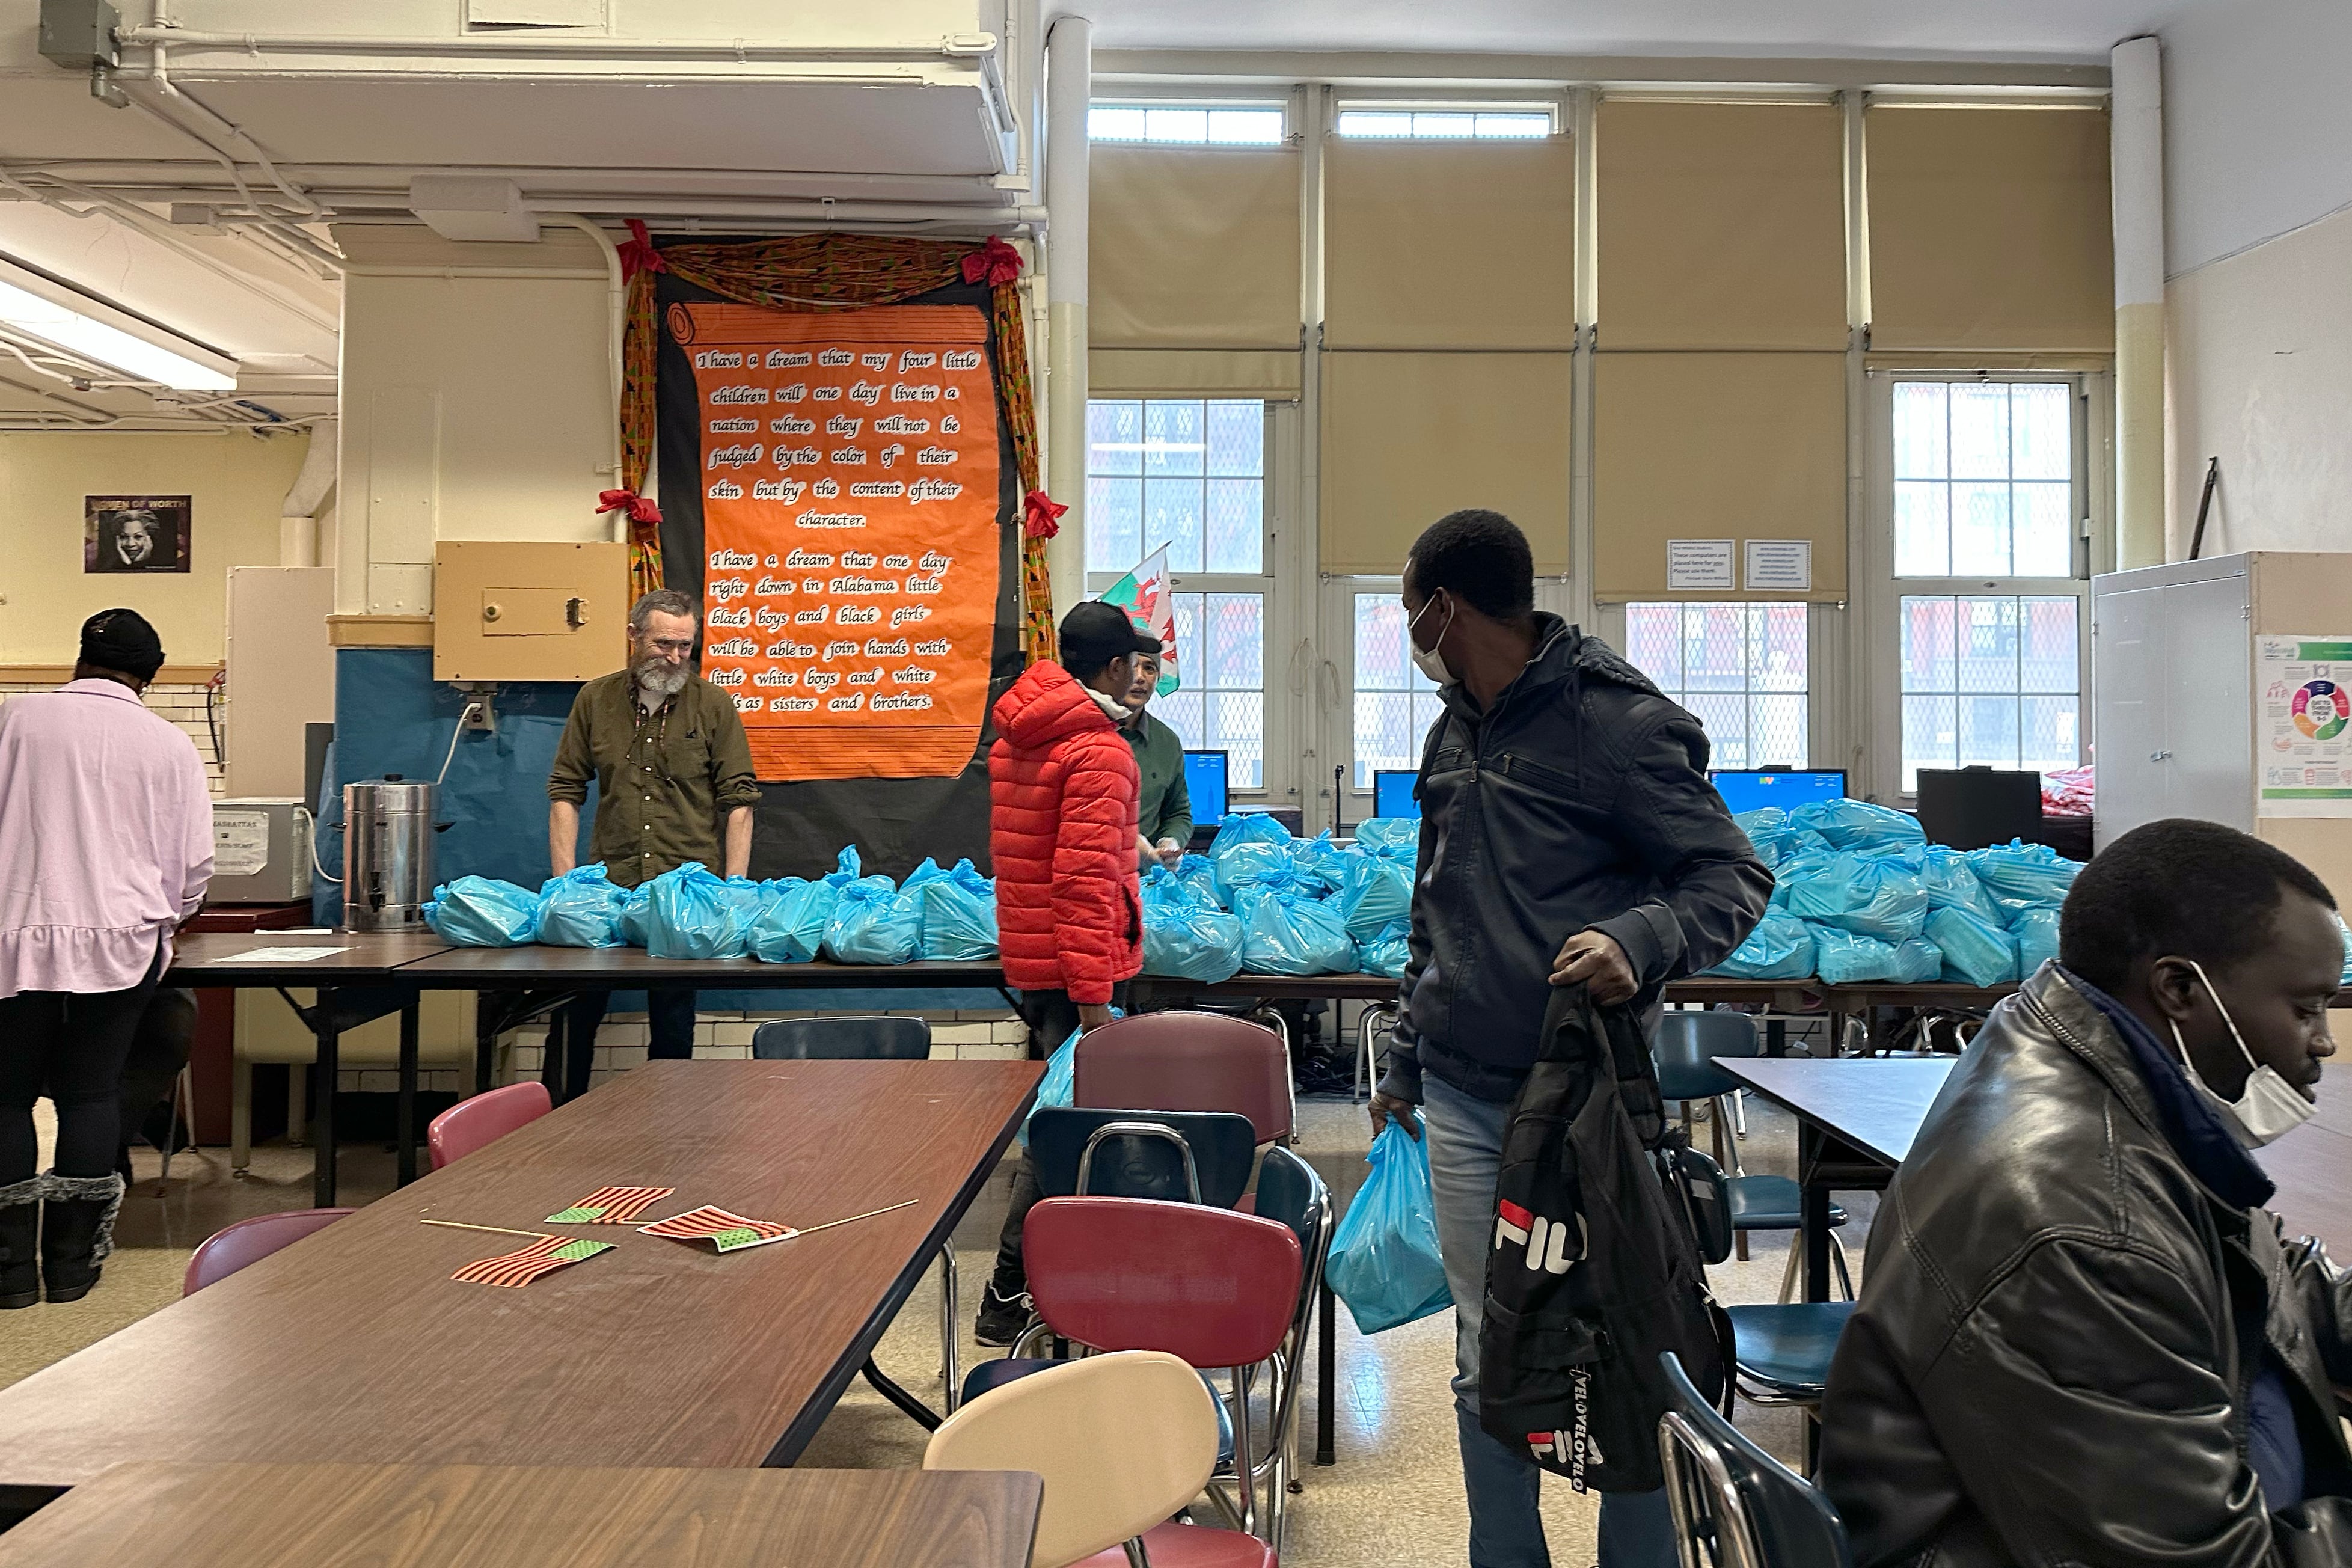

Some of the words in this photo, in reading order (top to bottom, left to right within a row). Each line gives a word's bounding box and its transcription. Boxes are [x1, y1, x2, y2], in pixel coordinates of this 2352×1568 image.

[697, 355, 706, 367] I
[710, 351, 741, 367] have
[749, 356, 758, 366] a
[768, 352, 809, 367] dream
[822, 349, 851, 364] that
[865, 355, 886, 370] my
[900, 351, 933, 373] four
[945, 352, 976, 369] little
[712, 387, 767, 403] children
[776, 385, 804, 401] will
[815, 390, 838, 399] one
[852, 383, 878, 405] day
[895, 384, 917, 400] live
[920, 387, 936, 399] in
[947, 388, 956, 398] a
[712, 418, 756, 432] nation
[772, 416, 810, 432] where
[828, 415, 857, 437] they
[876, 415, 904, 432] will
[904, 421, 927, 432] not
[944, 417, 958, 432] be
[709, 446, 761, 468] judged
[776, 446, 792, 468] by
[796, 447, 817, 463] the
[832, 447, 865, 462] color
[883, 445, 898, 467] of
[920, 447, 952, 463] their
[711, 482, 740, 497] skin
[756, 481, 779, 497] but
[782, 481, 800, 502] by
[816, 480, 836, 495] the
[853, 485, 902, 495] content
[911, 480, 926, 502] of
[927, 480, 959, 496] their
[148, 500, 187, 509] WORTH
[798, 510, 865, 526] character.
[712, 554, 720, 566] I
[723, 551, 753, 566] have
[768, 556, 777, 565] a
[788, 551, 831, 566] dream
[844, 551, 873, 566] that
[886, 557, 908, 568] one
[921, 553, 947, 574] day
[711, 578, 746, 599] right
[758, 578, 793, 594] down
[805, 579, 820, 591] in
[832, 577, 895, 592] Alabama
[908, 577, 939, 592] little
[711, 609, 747, 625] black
[758, 609, 787, 630] boys
[797, 607, 827, 622] and
[840, 607, 875, 623] black
[893, 605, 925, 626] girls
[711, 640, 740, 655] will
[740, 640, 755, 655] be
[769, 641, 796, 656] able
[799, 646, 813, 655] to
[825, 642, 856, 660] join
[868, 639, 907, 655] hands
[917, 639, 946, 654] with
[711, 669, 742, 684] little
[758, 669, 794, 684] white
[807, 669, 836, 690] boys
[850, 667, 880, 683] and
[895, 667, 931, 682] white
[745, 699, 761, 709] as
[773, 698, 814, 709] sisters
[831, 694, 862, 709] and
[873, 692, 931, 709] brothers.
